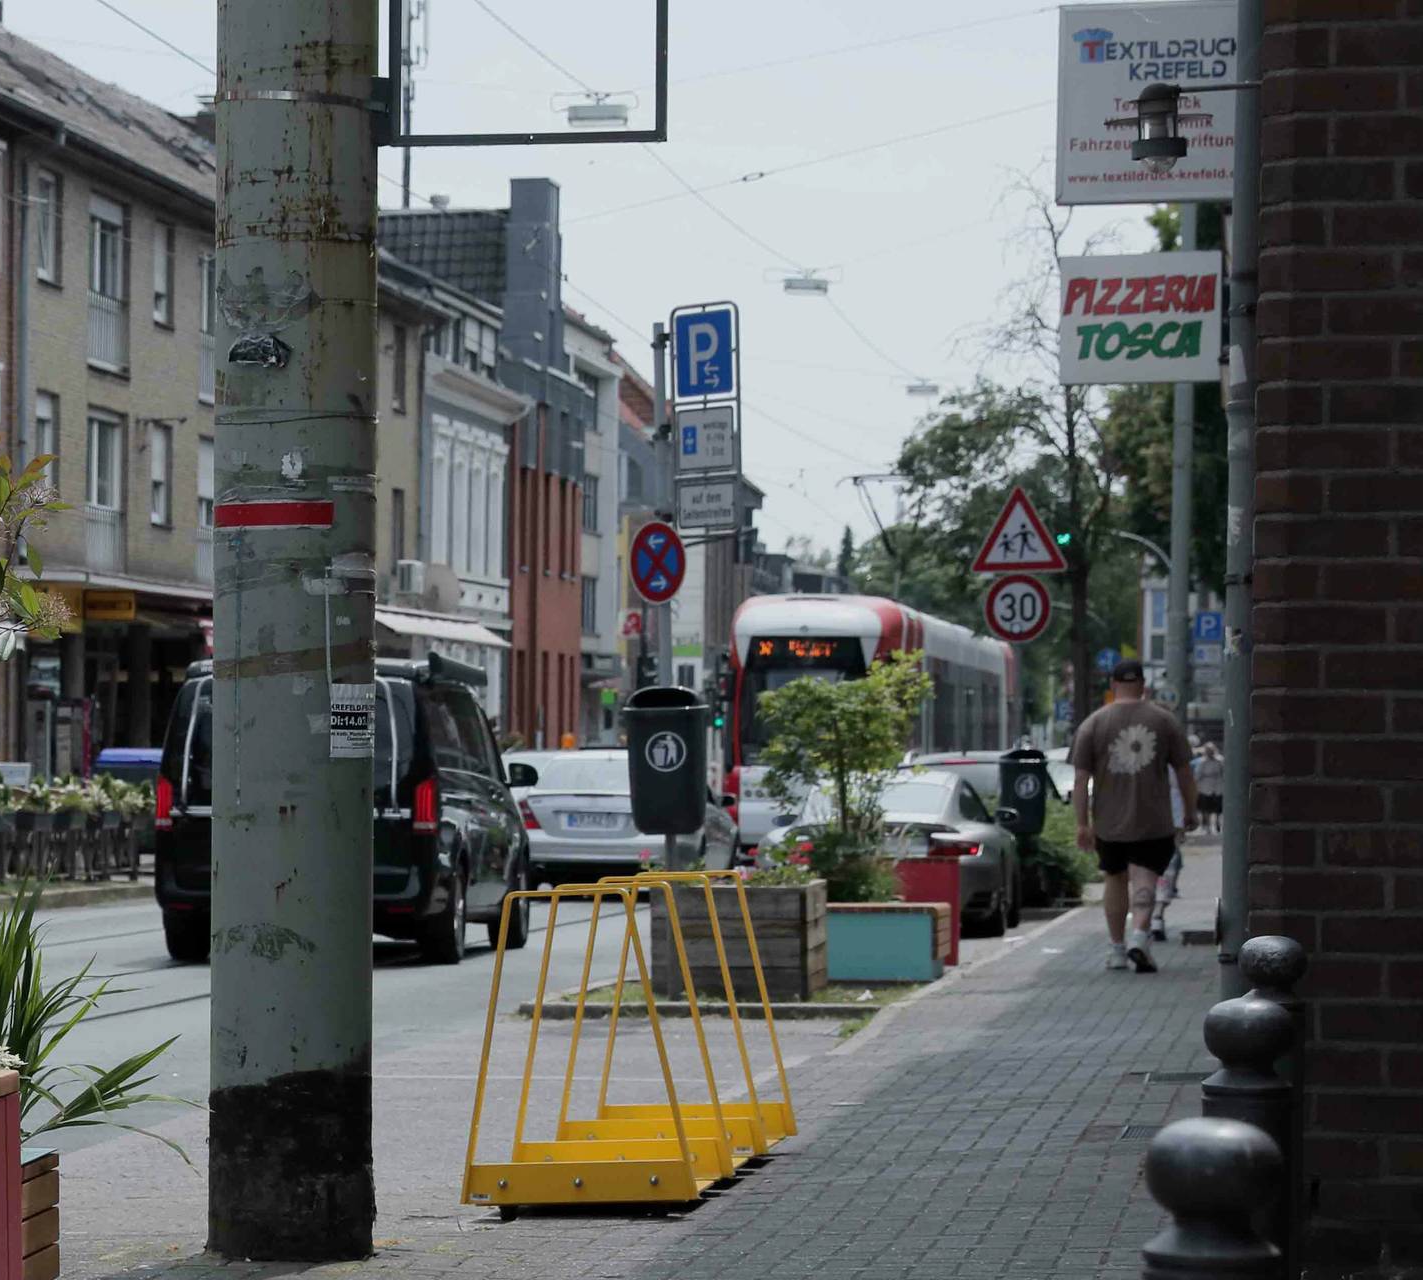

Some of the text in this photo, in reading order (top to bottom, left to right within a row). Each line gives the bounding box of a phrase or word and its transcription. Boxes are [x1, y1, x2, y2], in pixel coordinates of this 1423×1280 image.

[1129, 60, 1227, 81] KREFELD
[1062, 274, 1218, 316] PIZZERIA
[688, 322, 719, 386] P
[1076, 320, 1203, 361] TOSCA
[706, 492, 722, 504] dem
[999, 592, 1037, 622] 30
[1200, 615, 1217, 638] P
